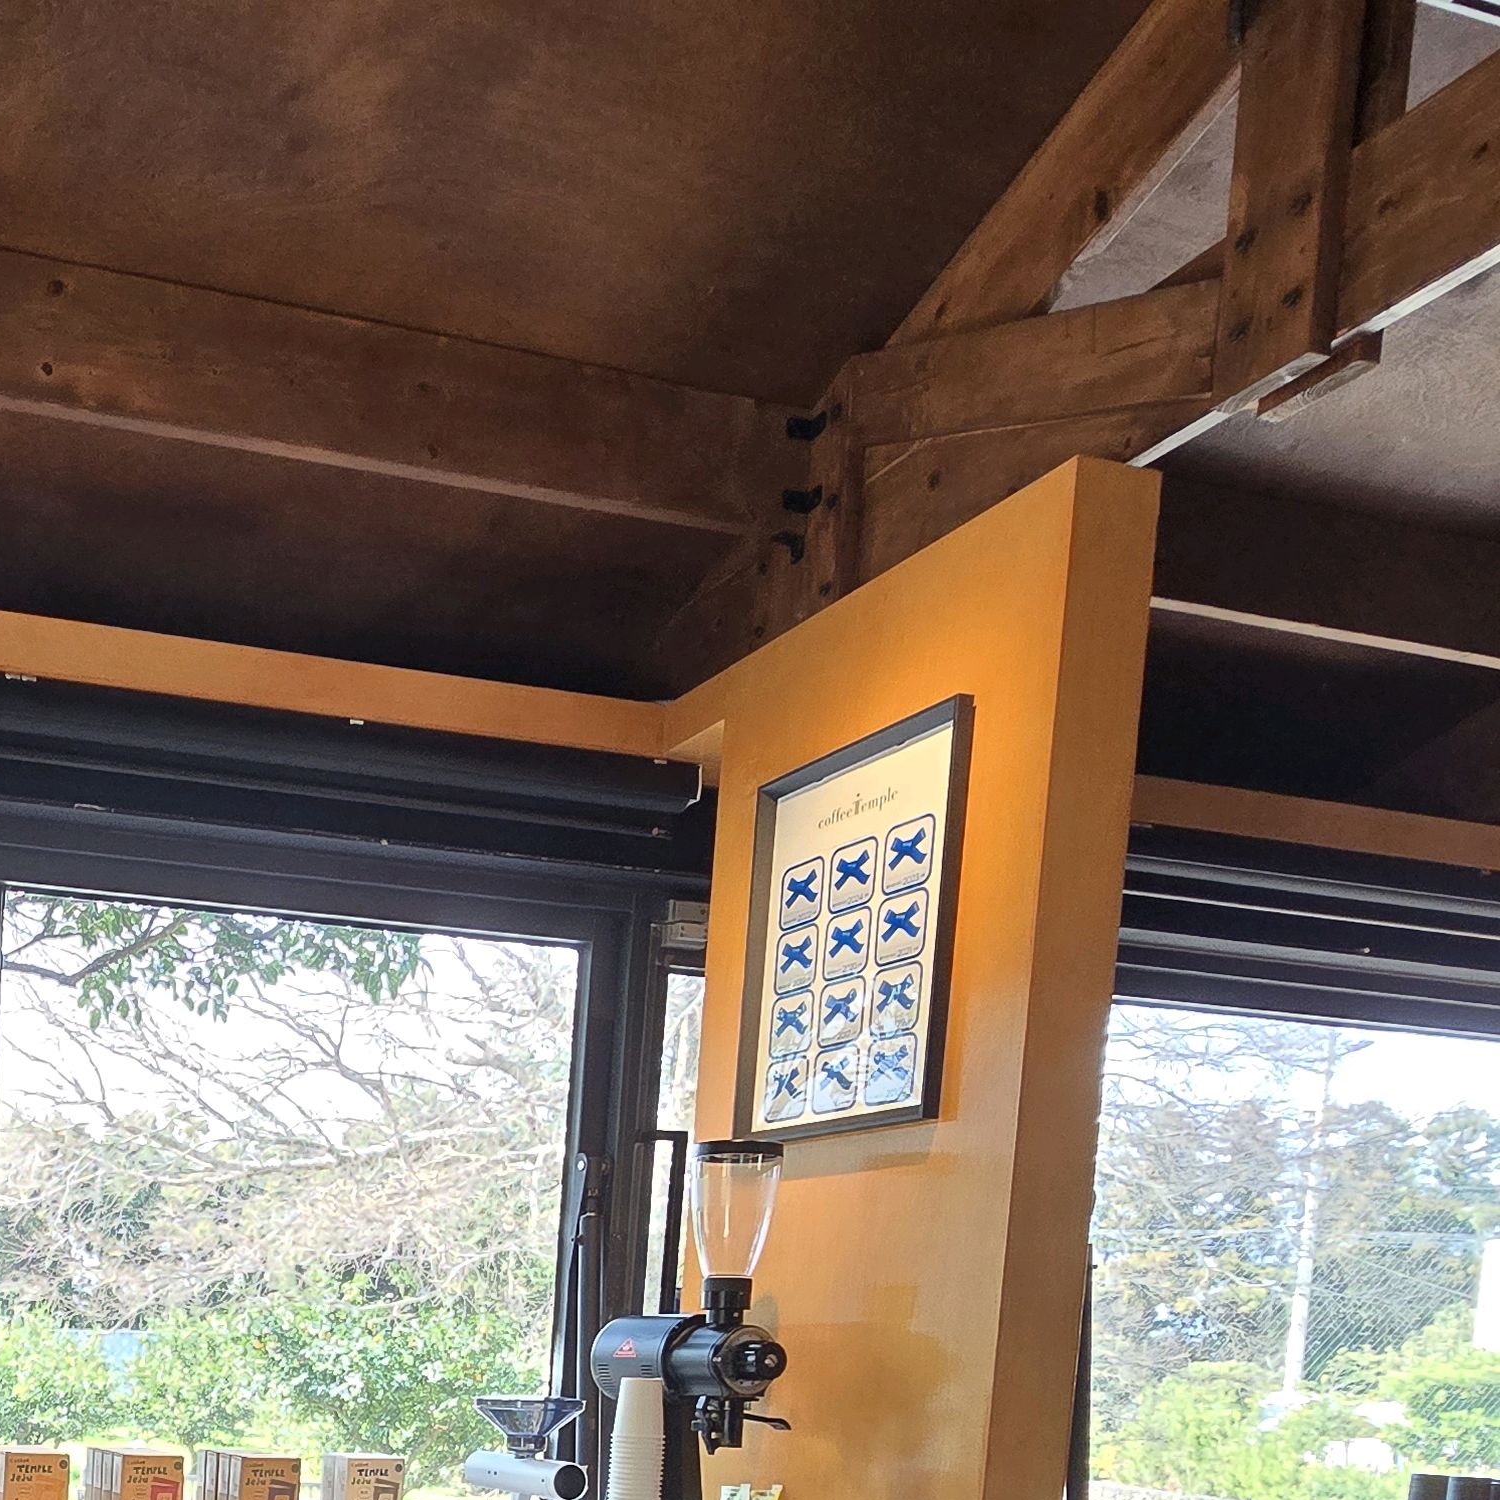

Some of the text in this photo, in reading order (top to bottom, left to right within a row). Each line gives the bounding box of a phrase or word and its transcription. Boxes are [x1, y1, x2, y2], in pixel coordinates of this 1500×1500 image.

[17, 1465, 52, 1473] TEMPLE
[133, 1466, 168, 1475] TEMPLE
[251, 1469, 285, 1477] TEMPLE
[357, 1468, 389, 1477] TEMPLE
